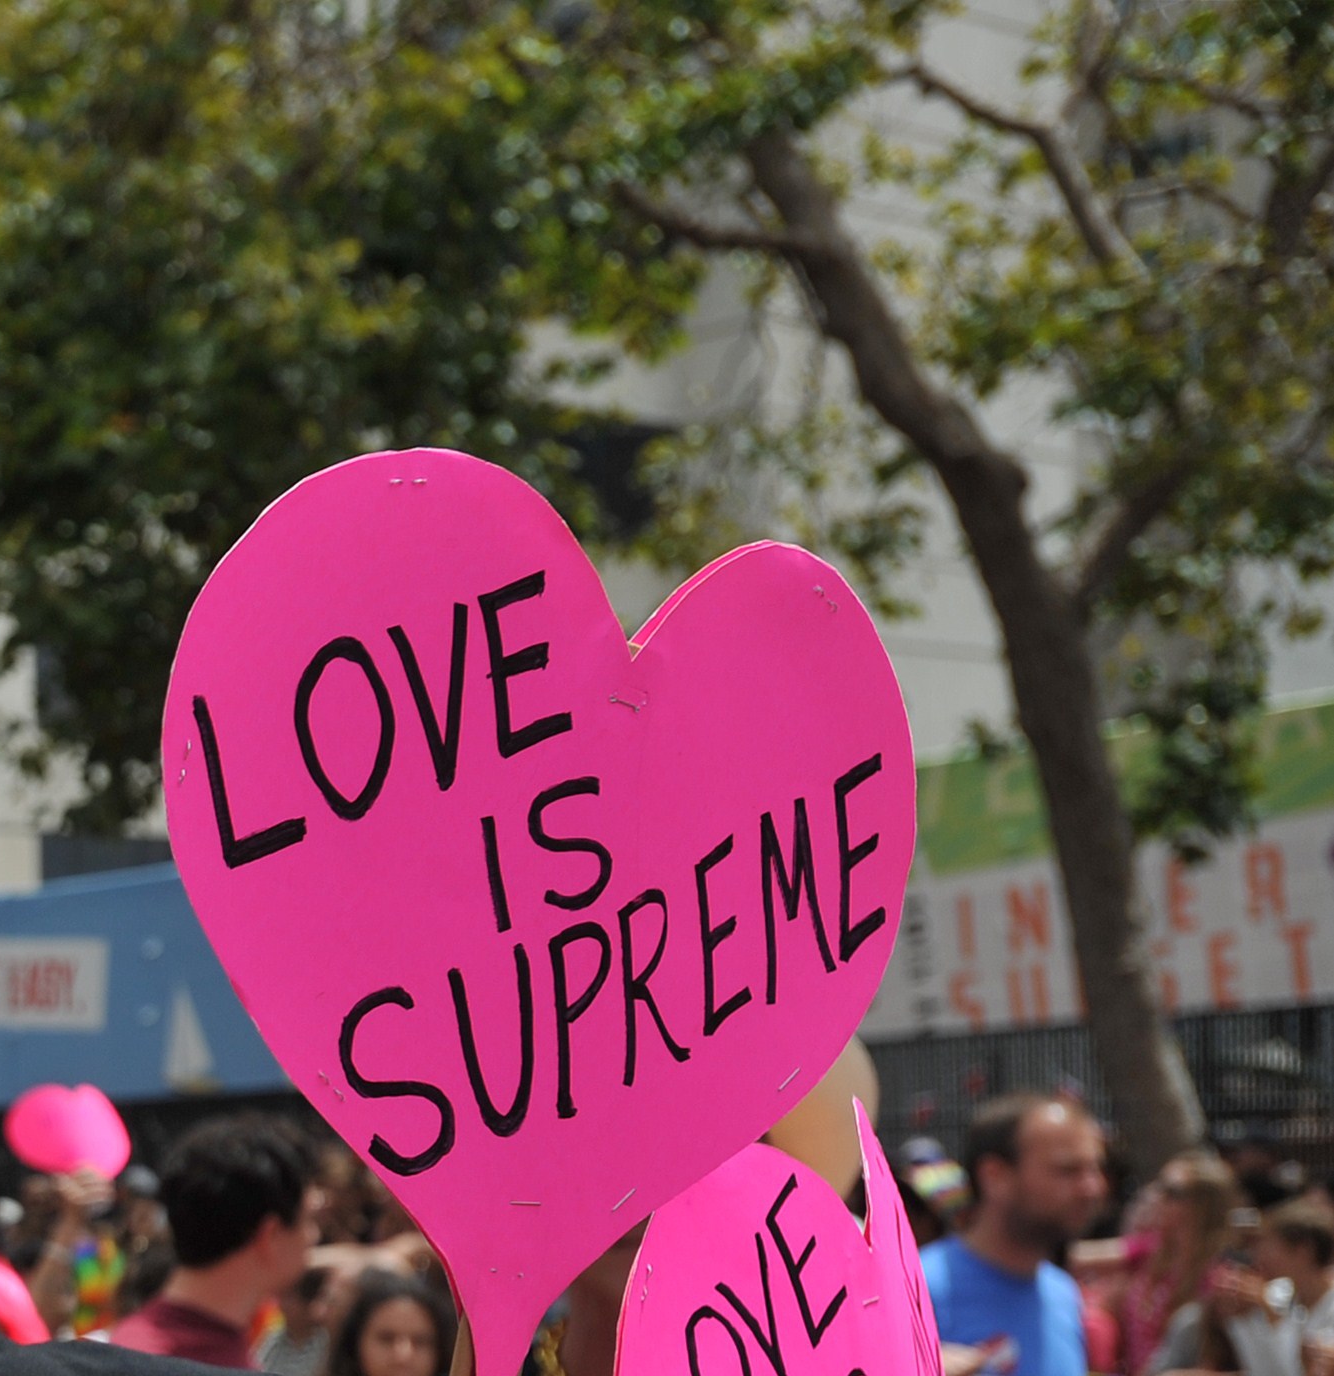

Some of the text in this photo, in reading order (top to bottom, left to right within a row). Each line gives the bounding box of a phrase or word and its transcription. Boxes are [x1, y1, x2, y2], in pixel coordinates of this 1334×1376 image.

[193, 570, 572, 868] LOVE
[339, 754, 886, 1177] SUPREME
[481, 776, 612, 932] IS
[956, 841, 1286, 963] INER
